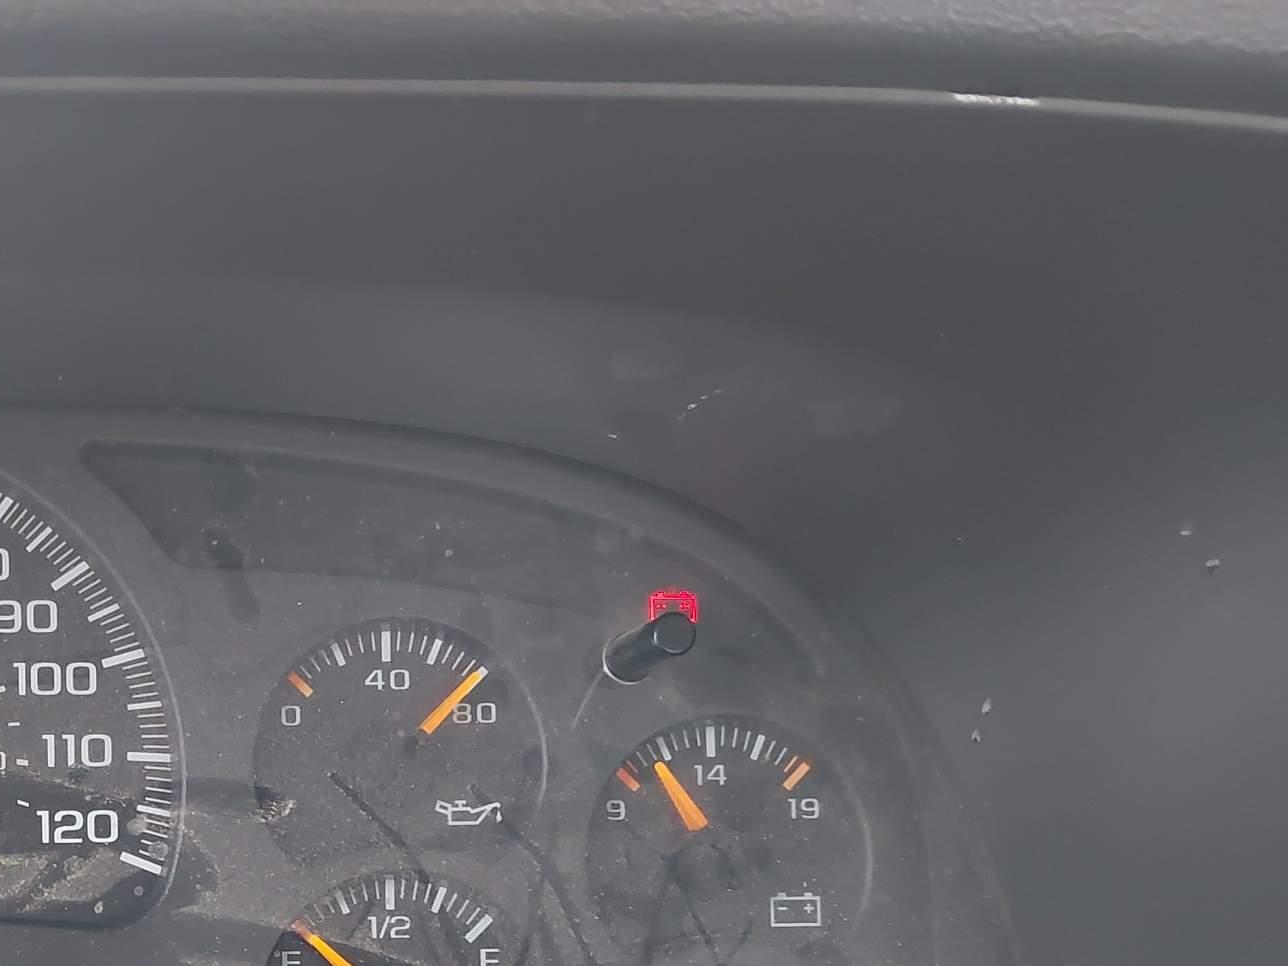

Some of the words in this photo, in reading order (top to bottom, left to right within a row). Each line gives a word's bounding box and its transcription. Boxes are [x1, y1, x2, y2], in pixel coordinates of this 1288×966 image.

[13, 661, 98, 697] 100
[364, 669, 410, 691] 40
[281, 705, 301, 726] 0
[452, 702, 497, 725] 80
[41, 734, 112, 768] 110
[693, 764, 728, 786] 14
[606, 799, 626, 821] 9
[787, 798, 820, 820] 19
[36, 809, 119, 845] 120
[367, 915, 411, 940] 1/2
